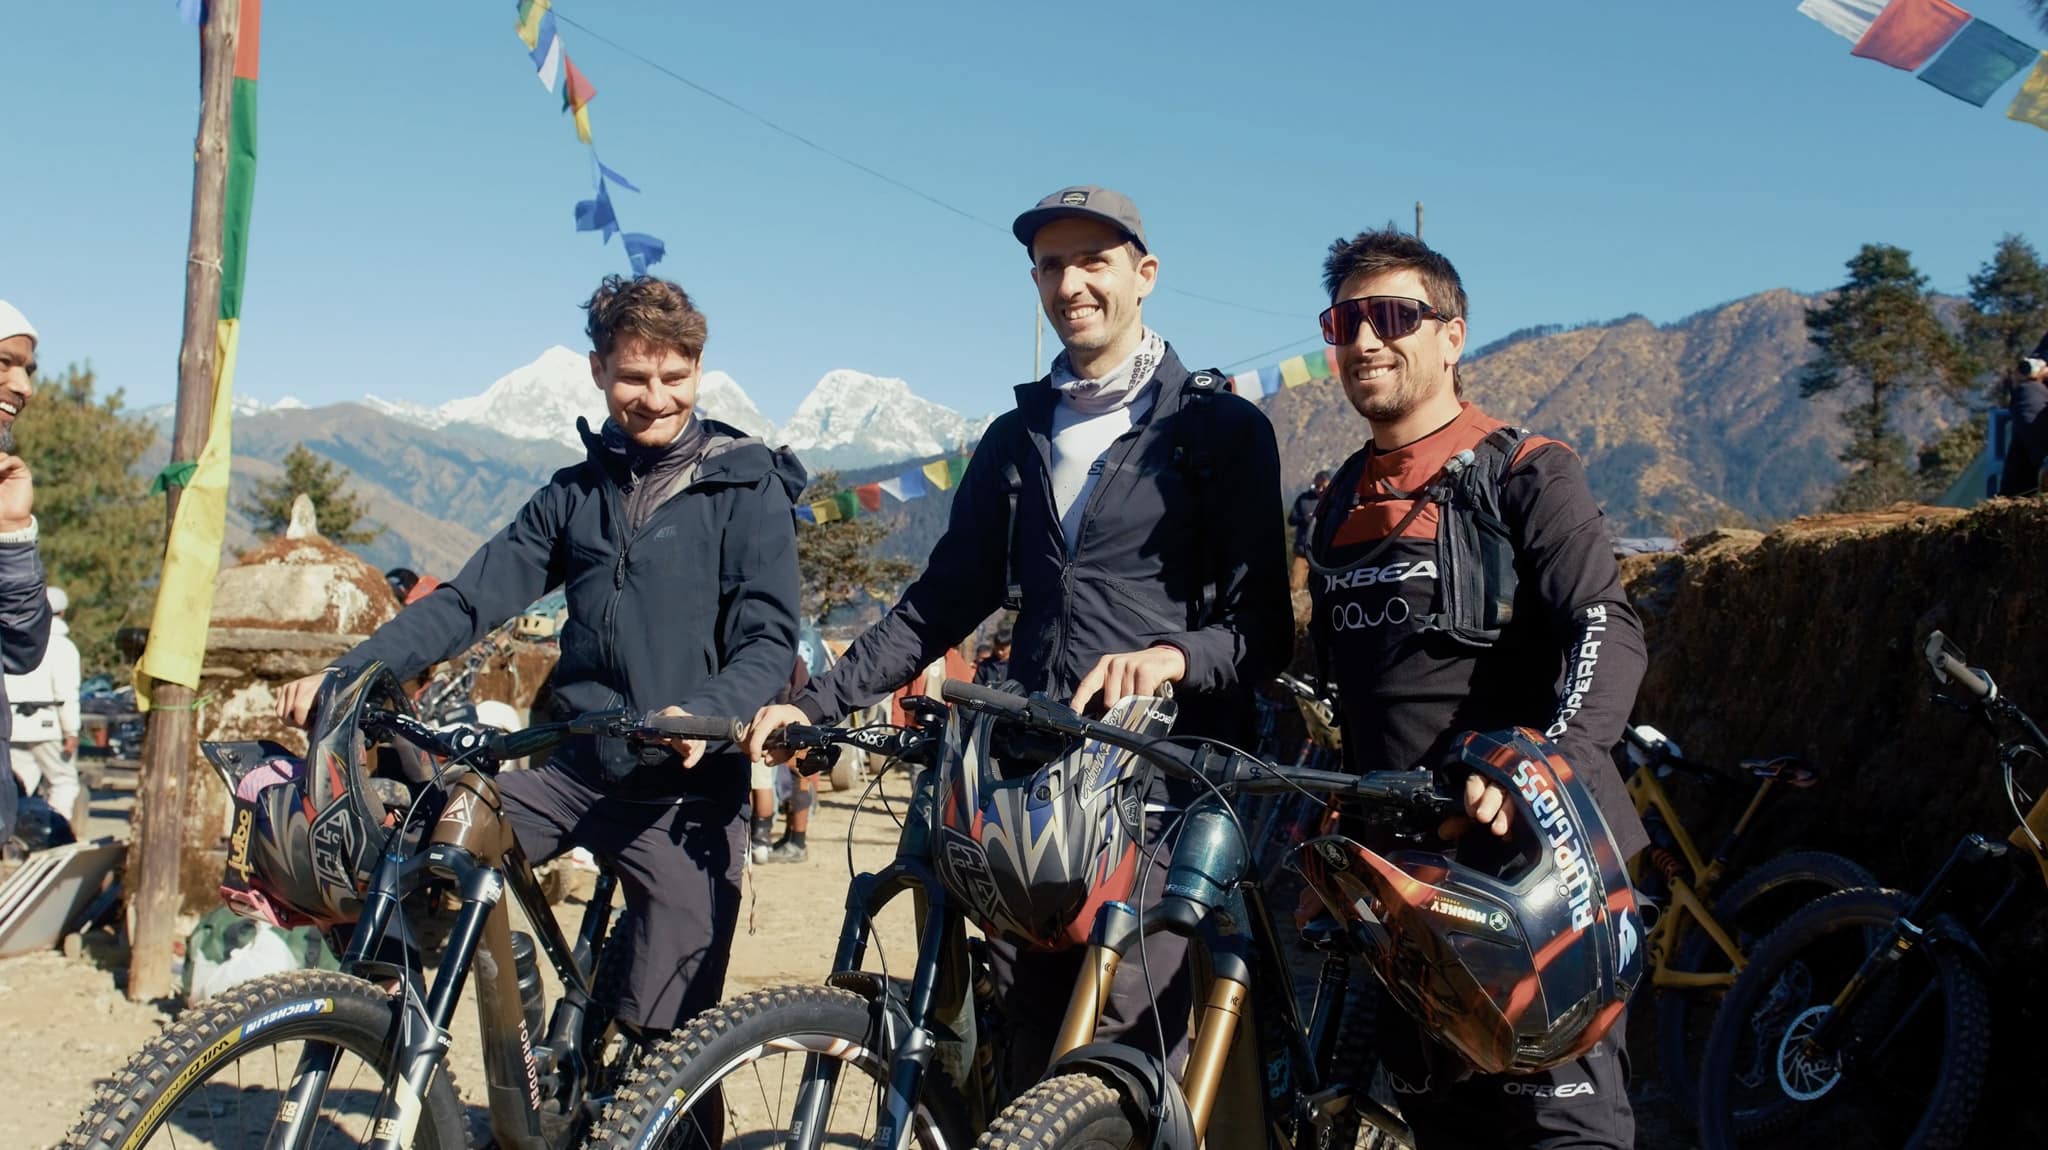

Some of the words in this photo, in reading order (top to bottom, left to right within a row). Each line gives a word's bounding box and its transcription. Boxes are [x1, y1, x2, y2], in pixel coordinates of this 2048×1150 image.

[1332, 596, 1410, 632] OQUO
[1430, 899, 1488, 925] MONKEY
[246, 1002, 313, 1035] MICHELIN
[189, 1039, 230, 1076] WILD
[518, 1019, 541, 1111] FORBIDDEN
[134, 1072, 190, 1139] ENDURO
[1503, 1080, 1595, 1098] ORBEA
